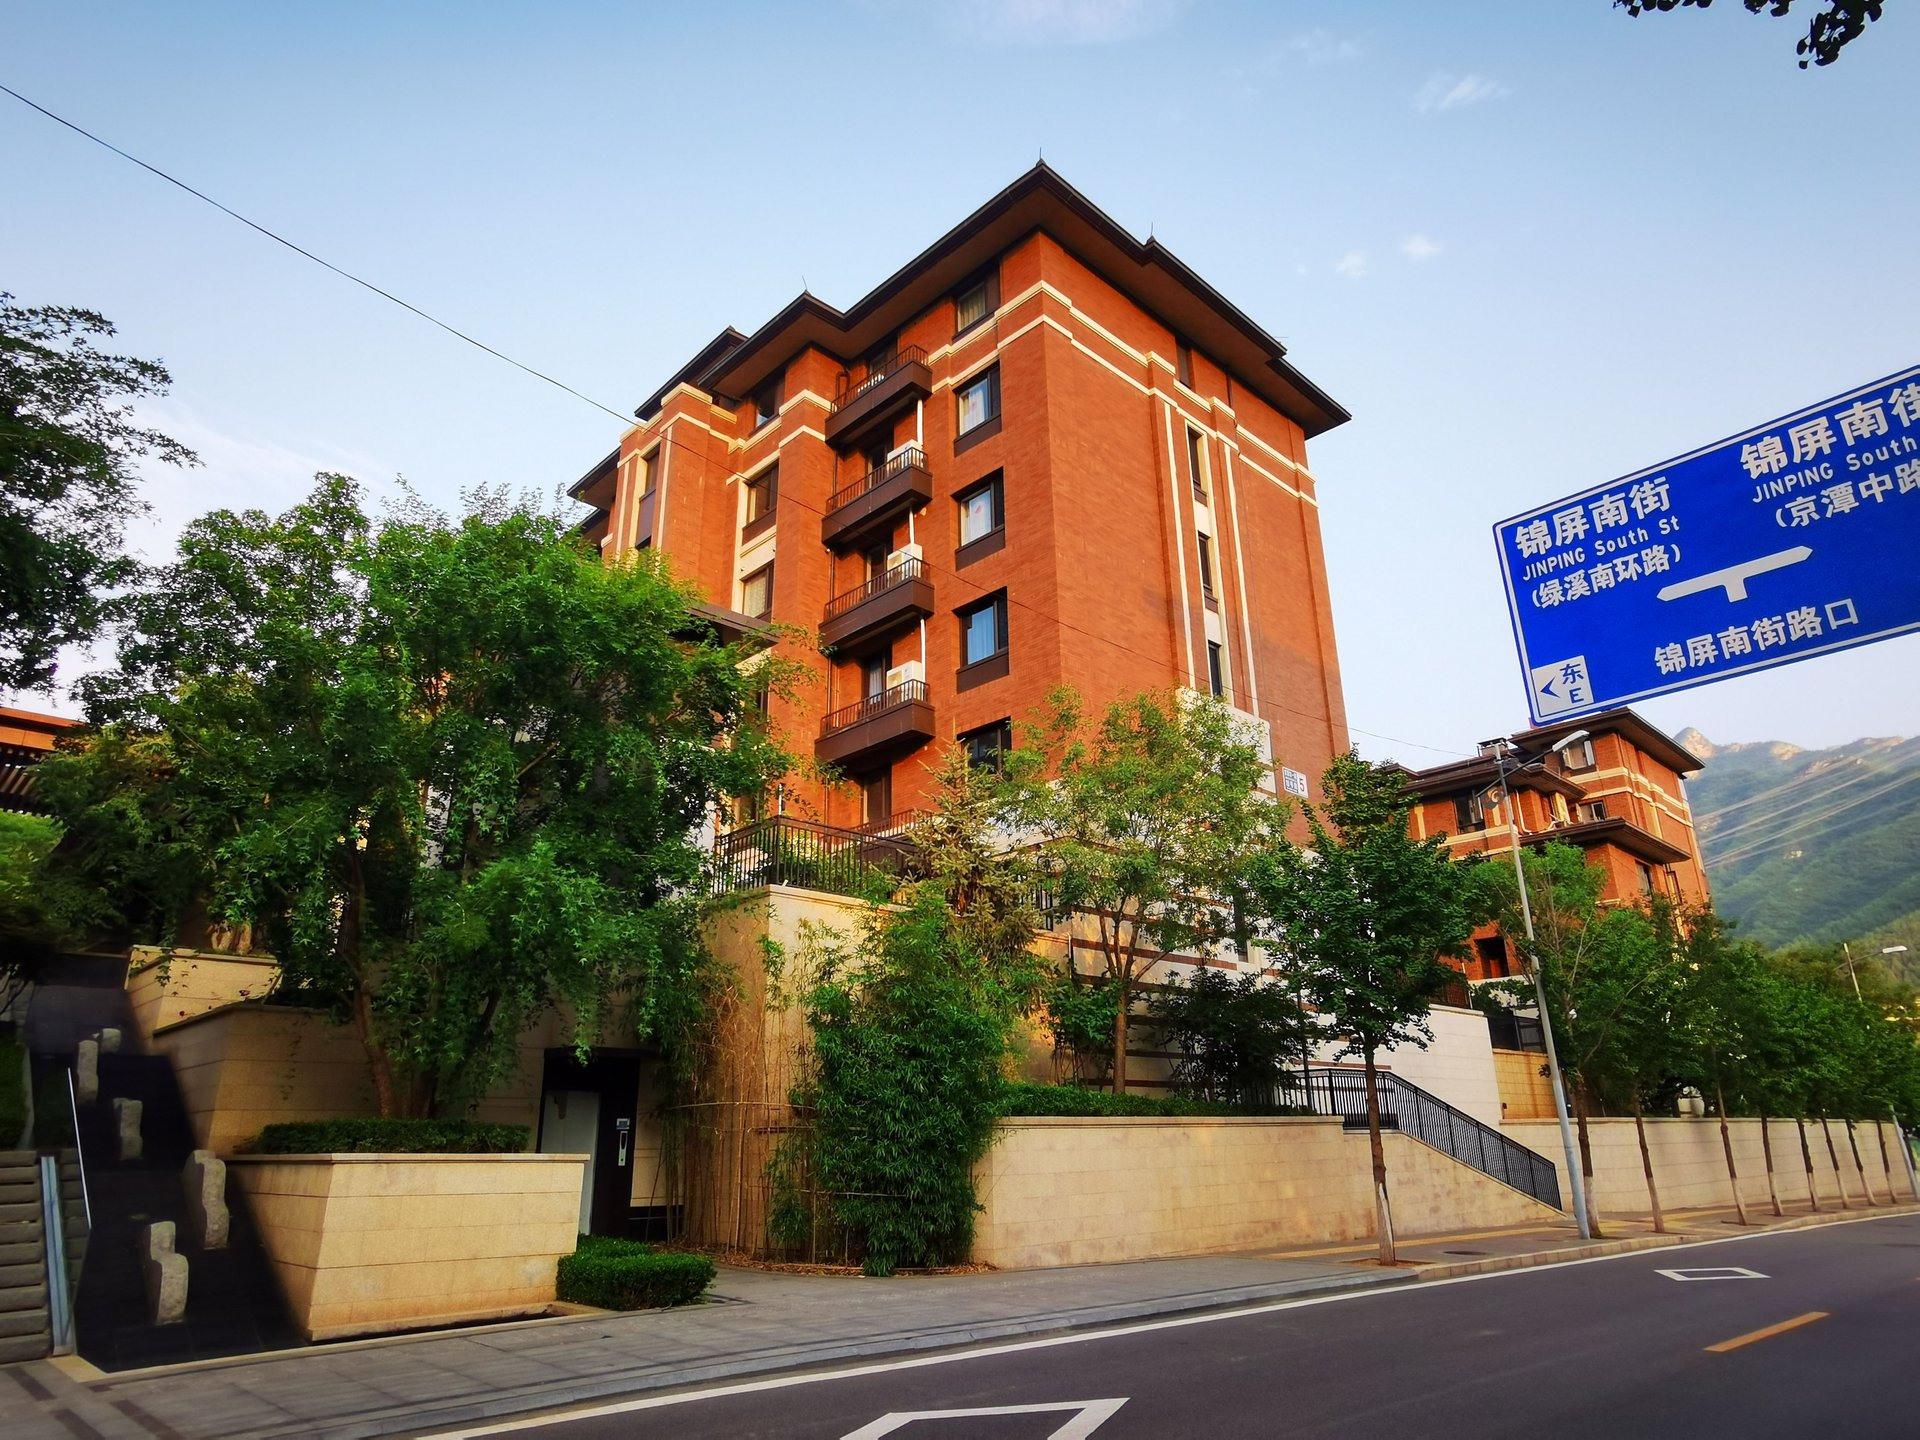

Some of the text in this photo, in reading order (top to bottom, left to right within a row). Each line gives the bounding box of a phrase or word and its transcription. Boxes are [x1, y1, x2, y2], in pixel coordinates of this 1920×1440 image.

[1752, 436, 1918, 503] JINPING South
[1515, 476, 1671, 559] 锦屏南街
[1522, 515, 1680, 581] JINPING South St
[1532, 543, 1681, 609] (绿溪南环路)
[1654, 598, 1859, 675] 锦屏南街路口
[1560, 663, 1584, 685] 东
[1569, 687, 1585, 704] E
[1299, 778, 1305, 792] 5
